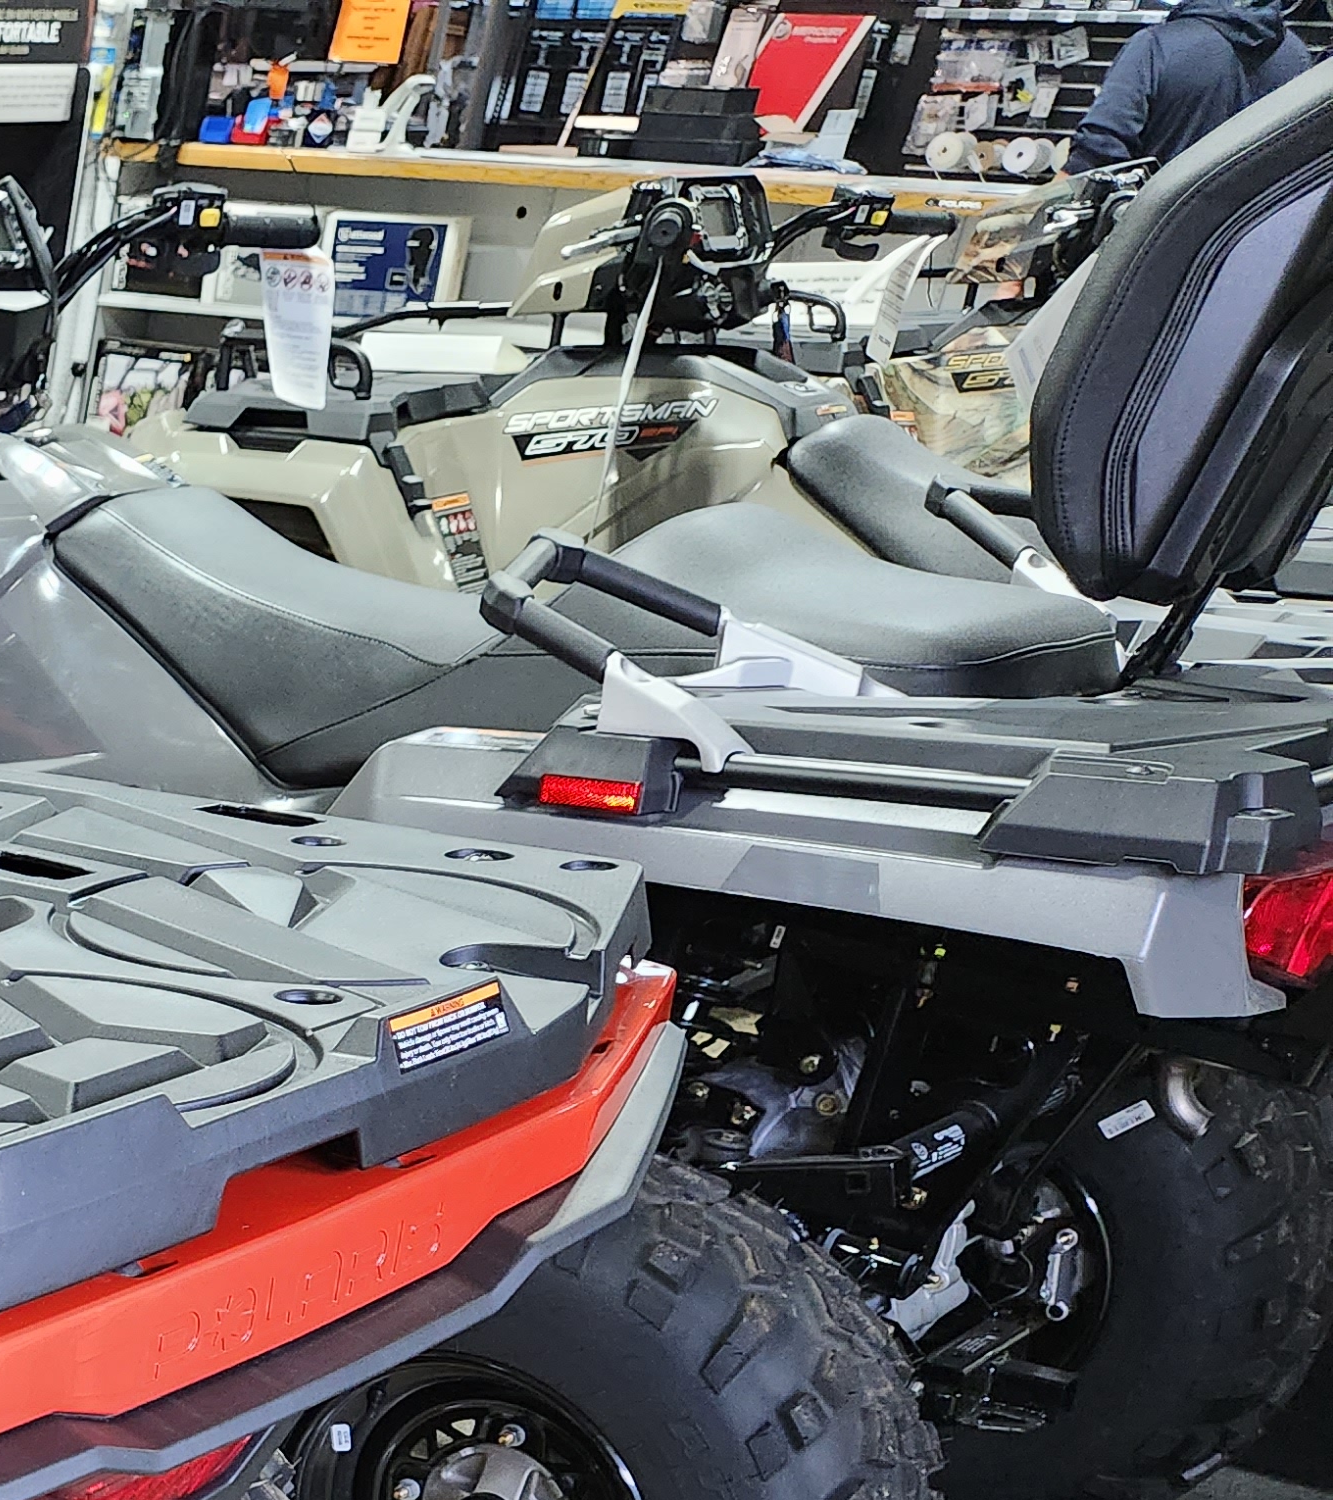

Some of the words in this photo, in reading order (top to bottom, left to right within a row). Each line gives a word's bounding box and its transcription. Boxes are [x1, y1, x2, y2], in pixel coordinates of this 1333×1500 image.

[939, 199, 983, 210] POLARIS
[503, 399, 719, 434] SPORTSMAN
[151, 1200, 446, 1386] POLARIS
